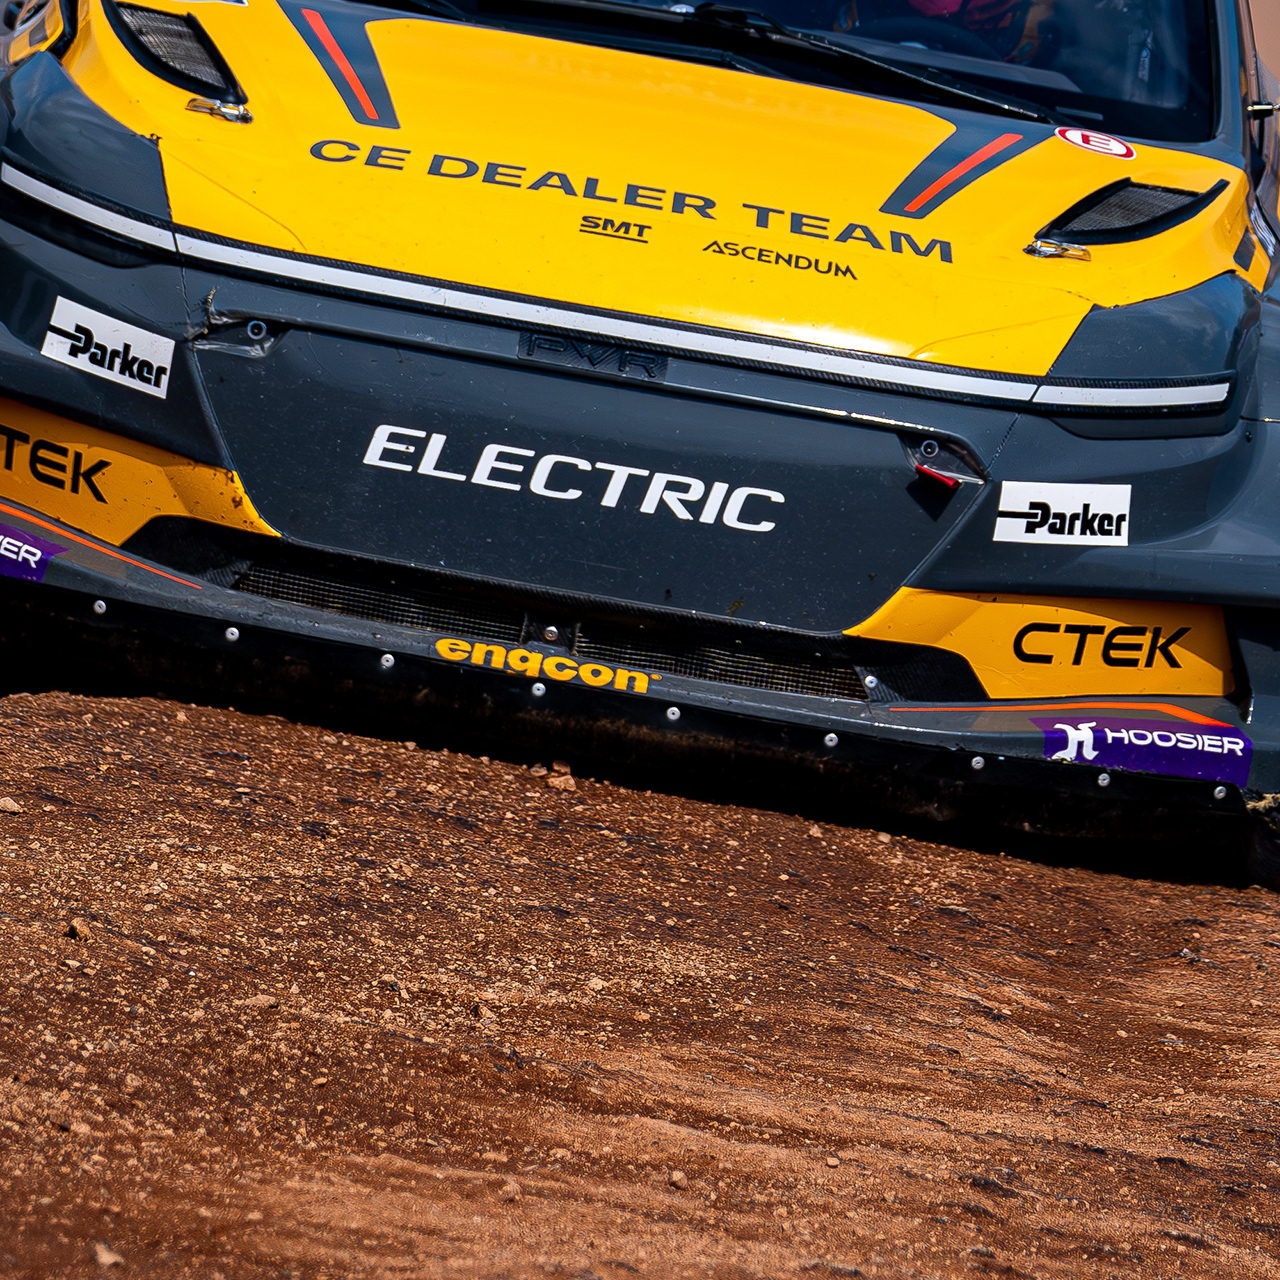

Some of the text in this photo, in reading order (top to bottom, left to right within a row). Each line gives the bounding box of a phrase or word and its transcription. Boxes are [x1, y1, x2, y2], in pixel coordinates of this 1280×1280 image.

[309, 139, 955, 264] CE DEALER TEAM
[579, 215, 653, 238] SMT
[701, 239, 859, 281] ASCENDUM
[66, 322, 168, 389] Parker
[526, 332, 658, 379] PWR
[362, 424, 785, 532] ELECTRIC
[1024, 501, 1128, 538] Parker
[1012, 622, 1193, 669] CTEK
[1103, 727, 1246, 757] HOOSIER
